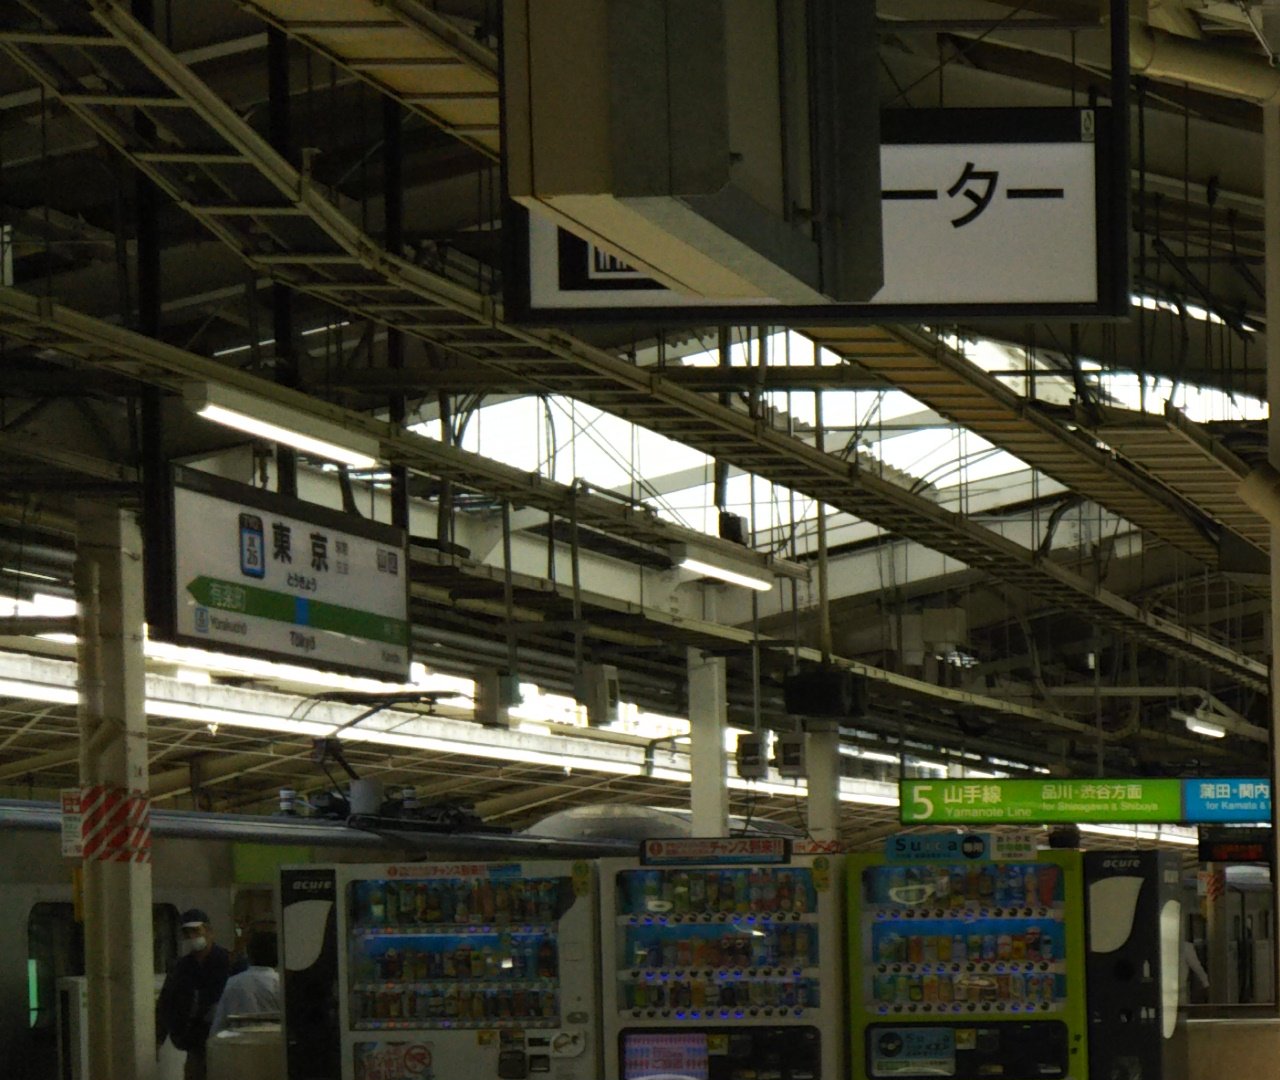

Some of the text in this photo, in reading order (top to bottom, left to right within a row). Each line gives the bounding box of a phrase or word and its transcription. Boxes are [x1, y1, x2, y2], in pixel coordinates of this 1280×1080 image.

[272, 522, 329, 573] 東京
[286, 572, 318, 593] とうきょう
[943, 784, 1003, 806] 山手線
[1042, 784, 1143, 801] 品川・渋谷方面
[912, 785, 934, 819] 5
[1120, 802, 1158, 814] Shibuya
[1221, 801, 1258, 811] Kamata
[945, 806, 1032, 818] Yamanote Line
[1102, 857, 1141, 868] acure
[292, 879, 333, 890] acure
